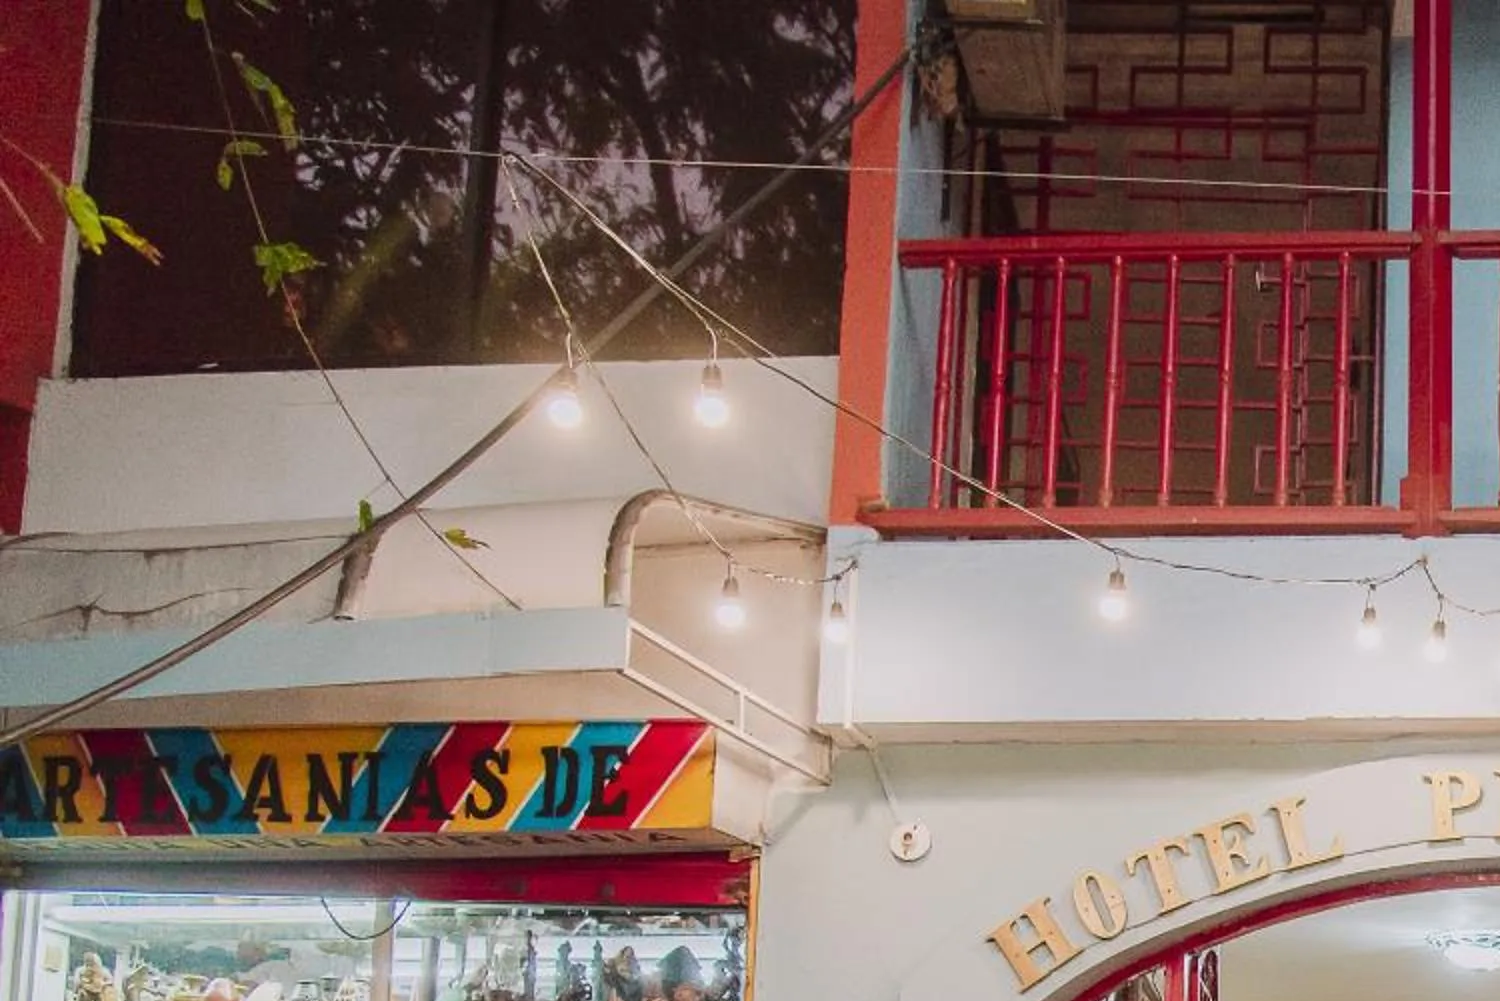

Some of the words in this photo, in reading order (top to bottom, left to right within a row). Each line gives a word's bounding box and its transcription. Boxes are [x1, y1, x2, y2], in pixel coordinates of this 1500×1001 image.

[0, 748, 510, 825] ARTESANIAS
[530, 745, 630, 818] DE
[984, 798, 1344, 993] HOTEL
